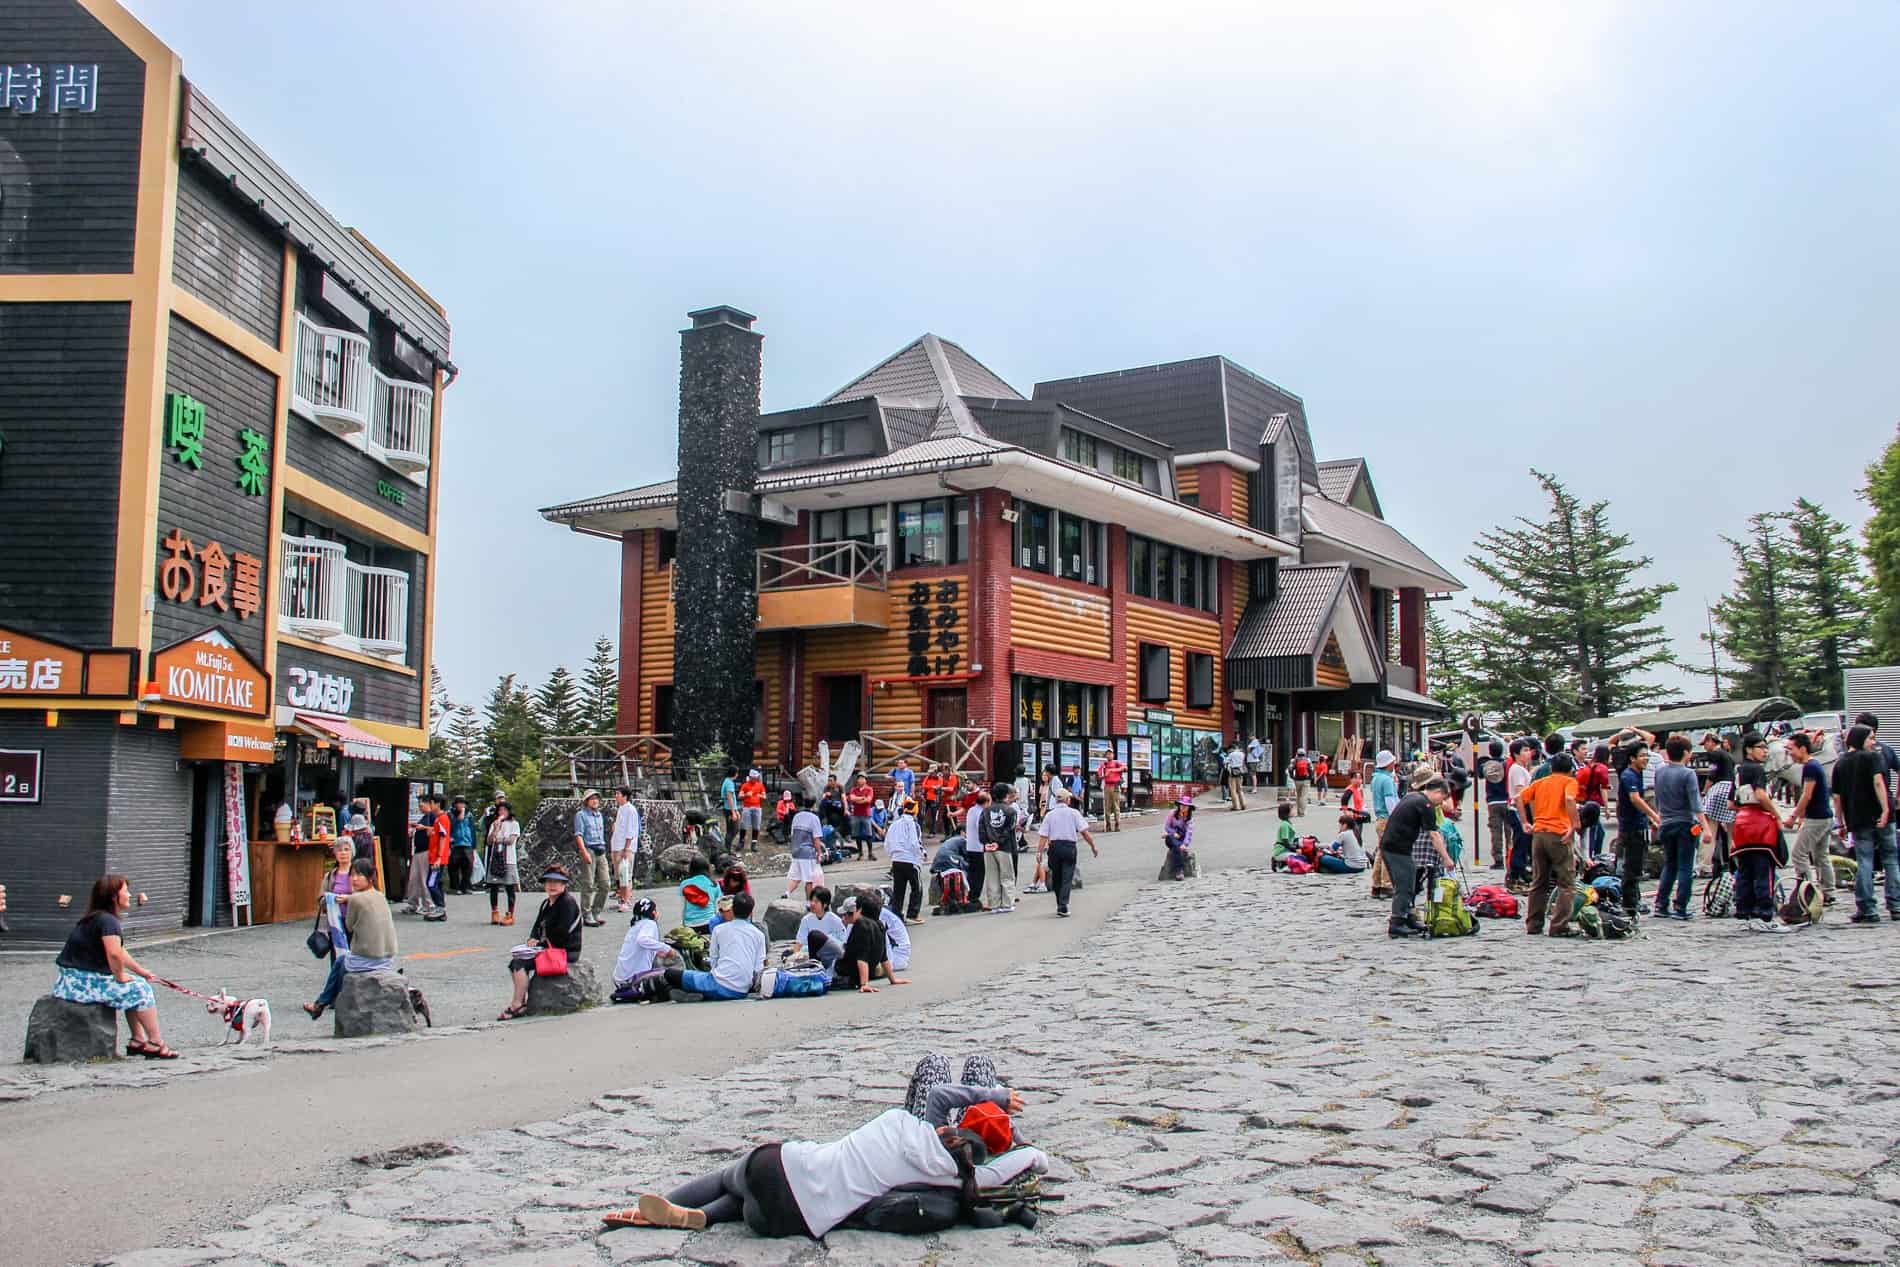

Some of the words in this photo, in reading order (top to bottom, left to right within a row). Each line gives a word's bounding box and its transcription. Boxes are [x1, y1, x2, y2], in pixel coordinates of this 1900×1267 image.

[0, 63, 99, 113] 時間
[167, 392, 269, 497] 喫茶
[377, 479, 407, 507] COFFEE
[159, 527, 263, 621] お食事
[935, 578, 961, 675] おみやげ
[0, 658, 64, 690] 売店
[196, 650, 222, 674] Mt.Fuji
[168, 665, 254, 709] KOMITAKE
[287, 667, 355, 714] こみたけ
[244, 735, 273, 751] Welcome
